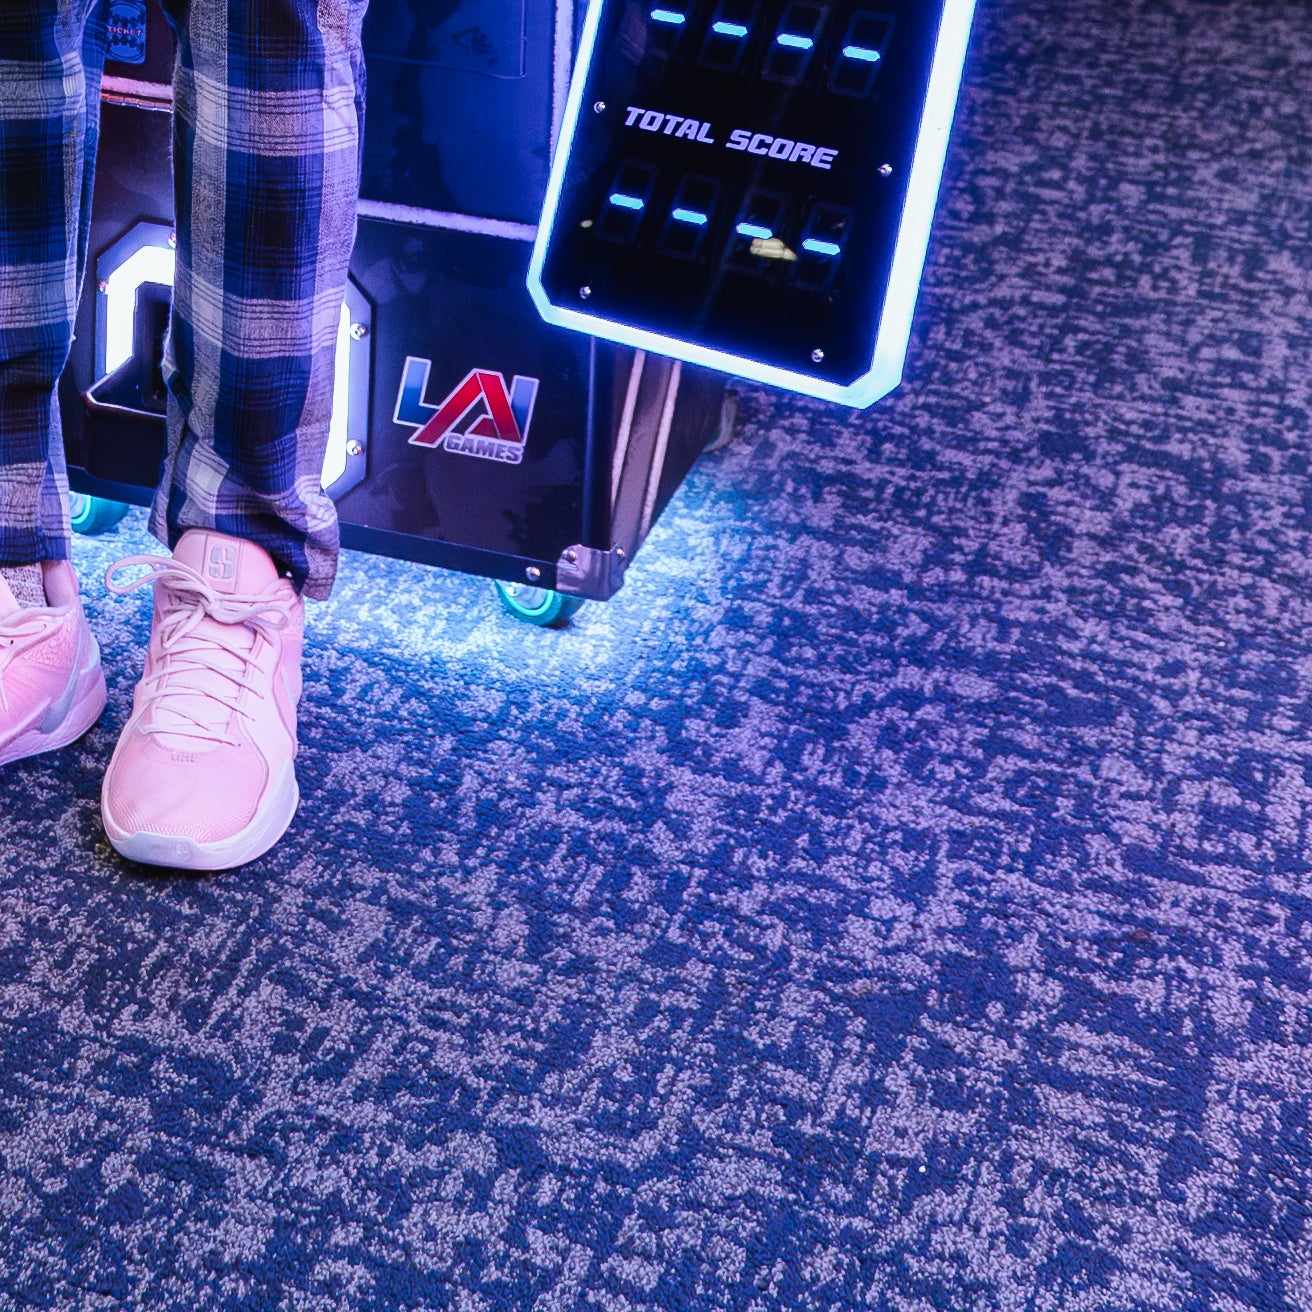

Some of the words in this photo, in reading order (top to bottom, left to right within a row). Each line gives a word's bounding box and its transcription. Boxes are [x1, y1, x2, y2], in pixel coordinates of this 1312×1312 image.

[624, 106, 715, 145] TOTAL
[725, 129, 839, 170] SCORE
[393, 356, 539, 449] LAI
[446, 434, 524, 463] GAMES
